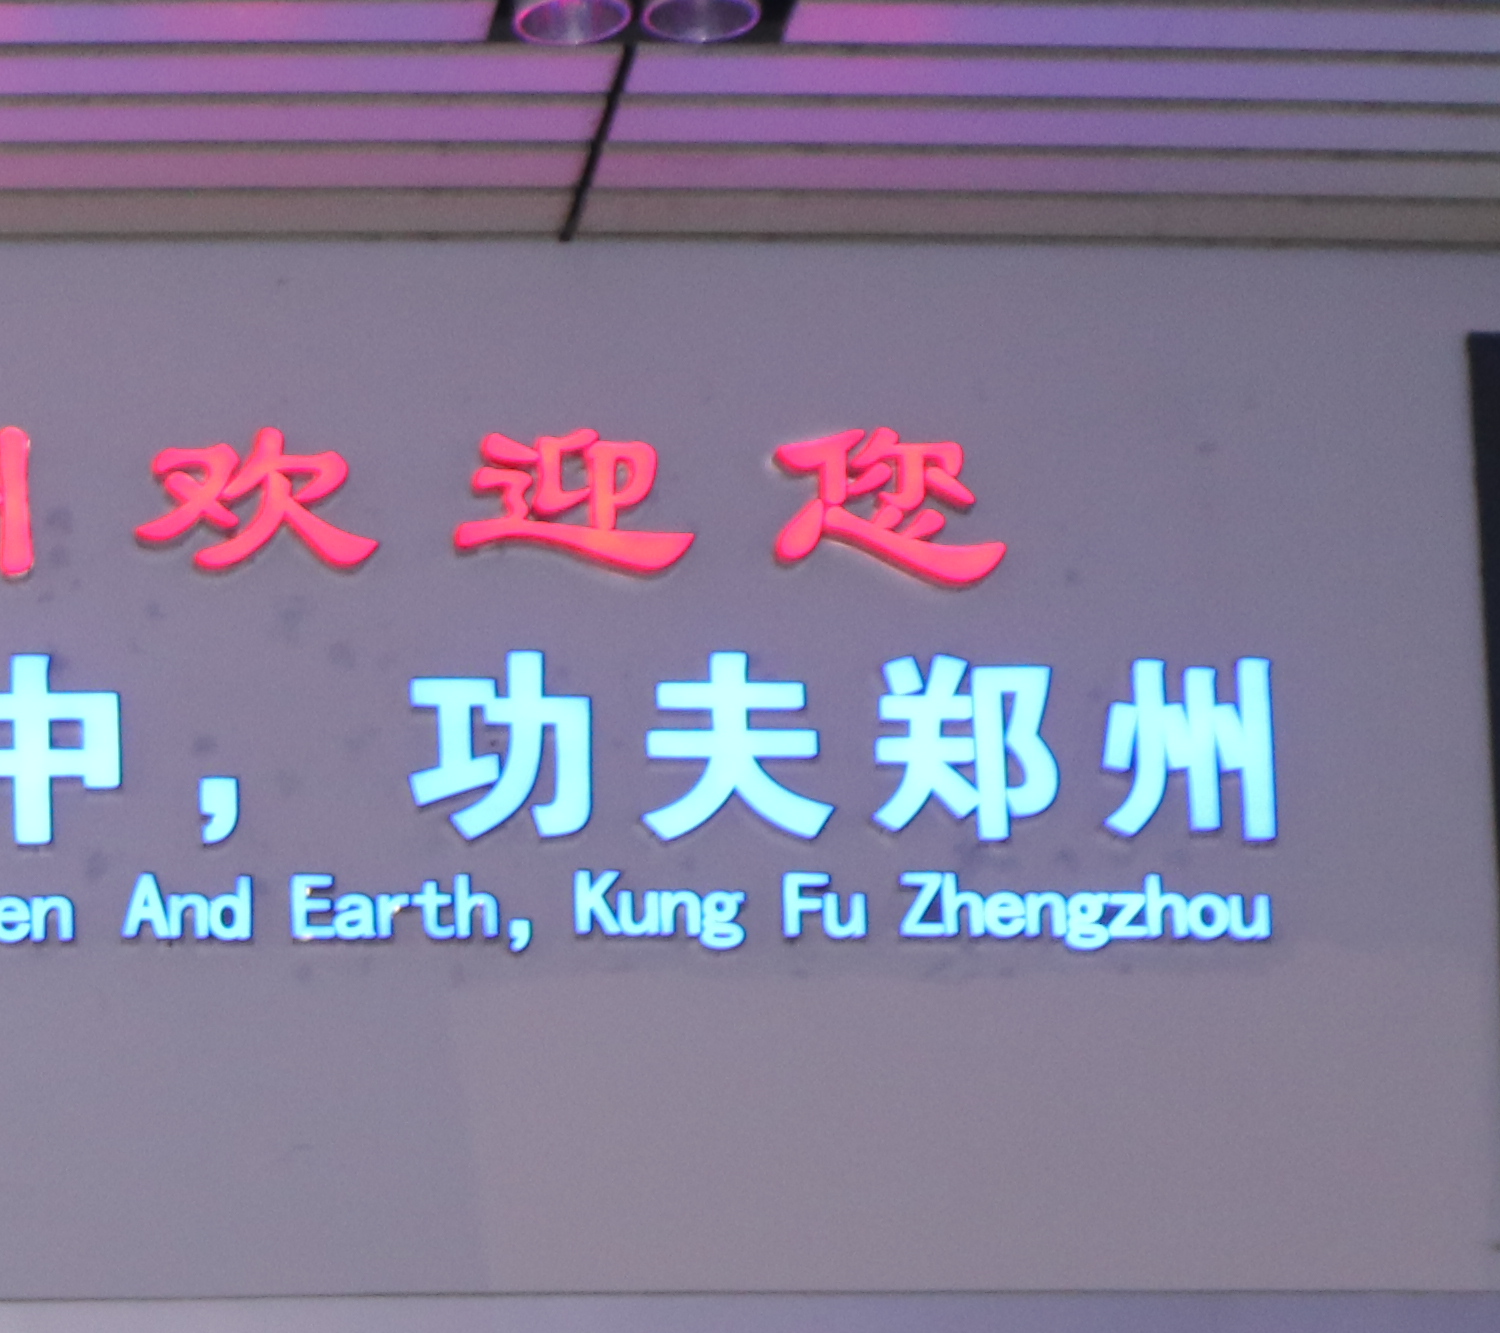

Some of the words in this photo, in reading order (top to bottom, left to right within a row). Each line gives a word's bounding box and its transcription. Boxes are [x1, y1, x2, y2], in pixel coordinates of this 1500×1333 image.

[123, 873, 252, 940] And
[290, 874, 531, 950] Earth,
[574, 870, 746, 950] Kung
[783, 872, 867, 938] Fu
[901, 872, 1271, 950] Zhengzhou
